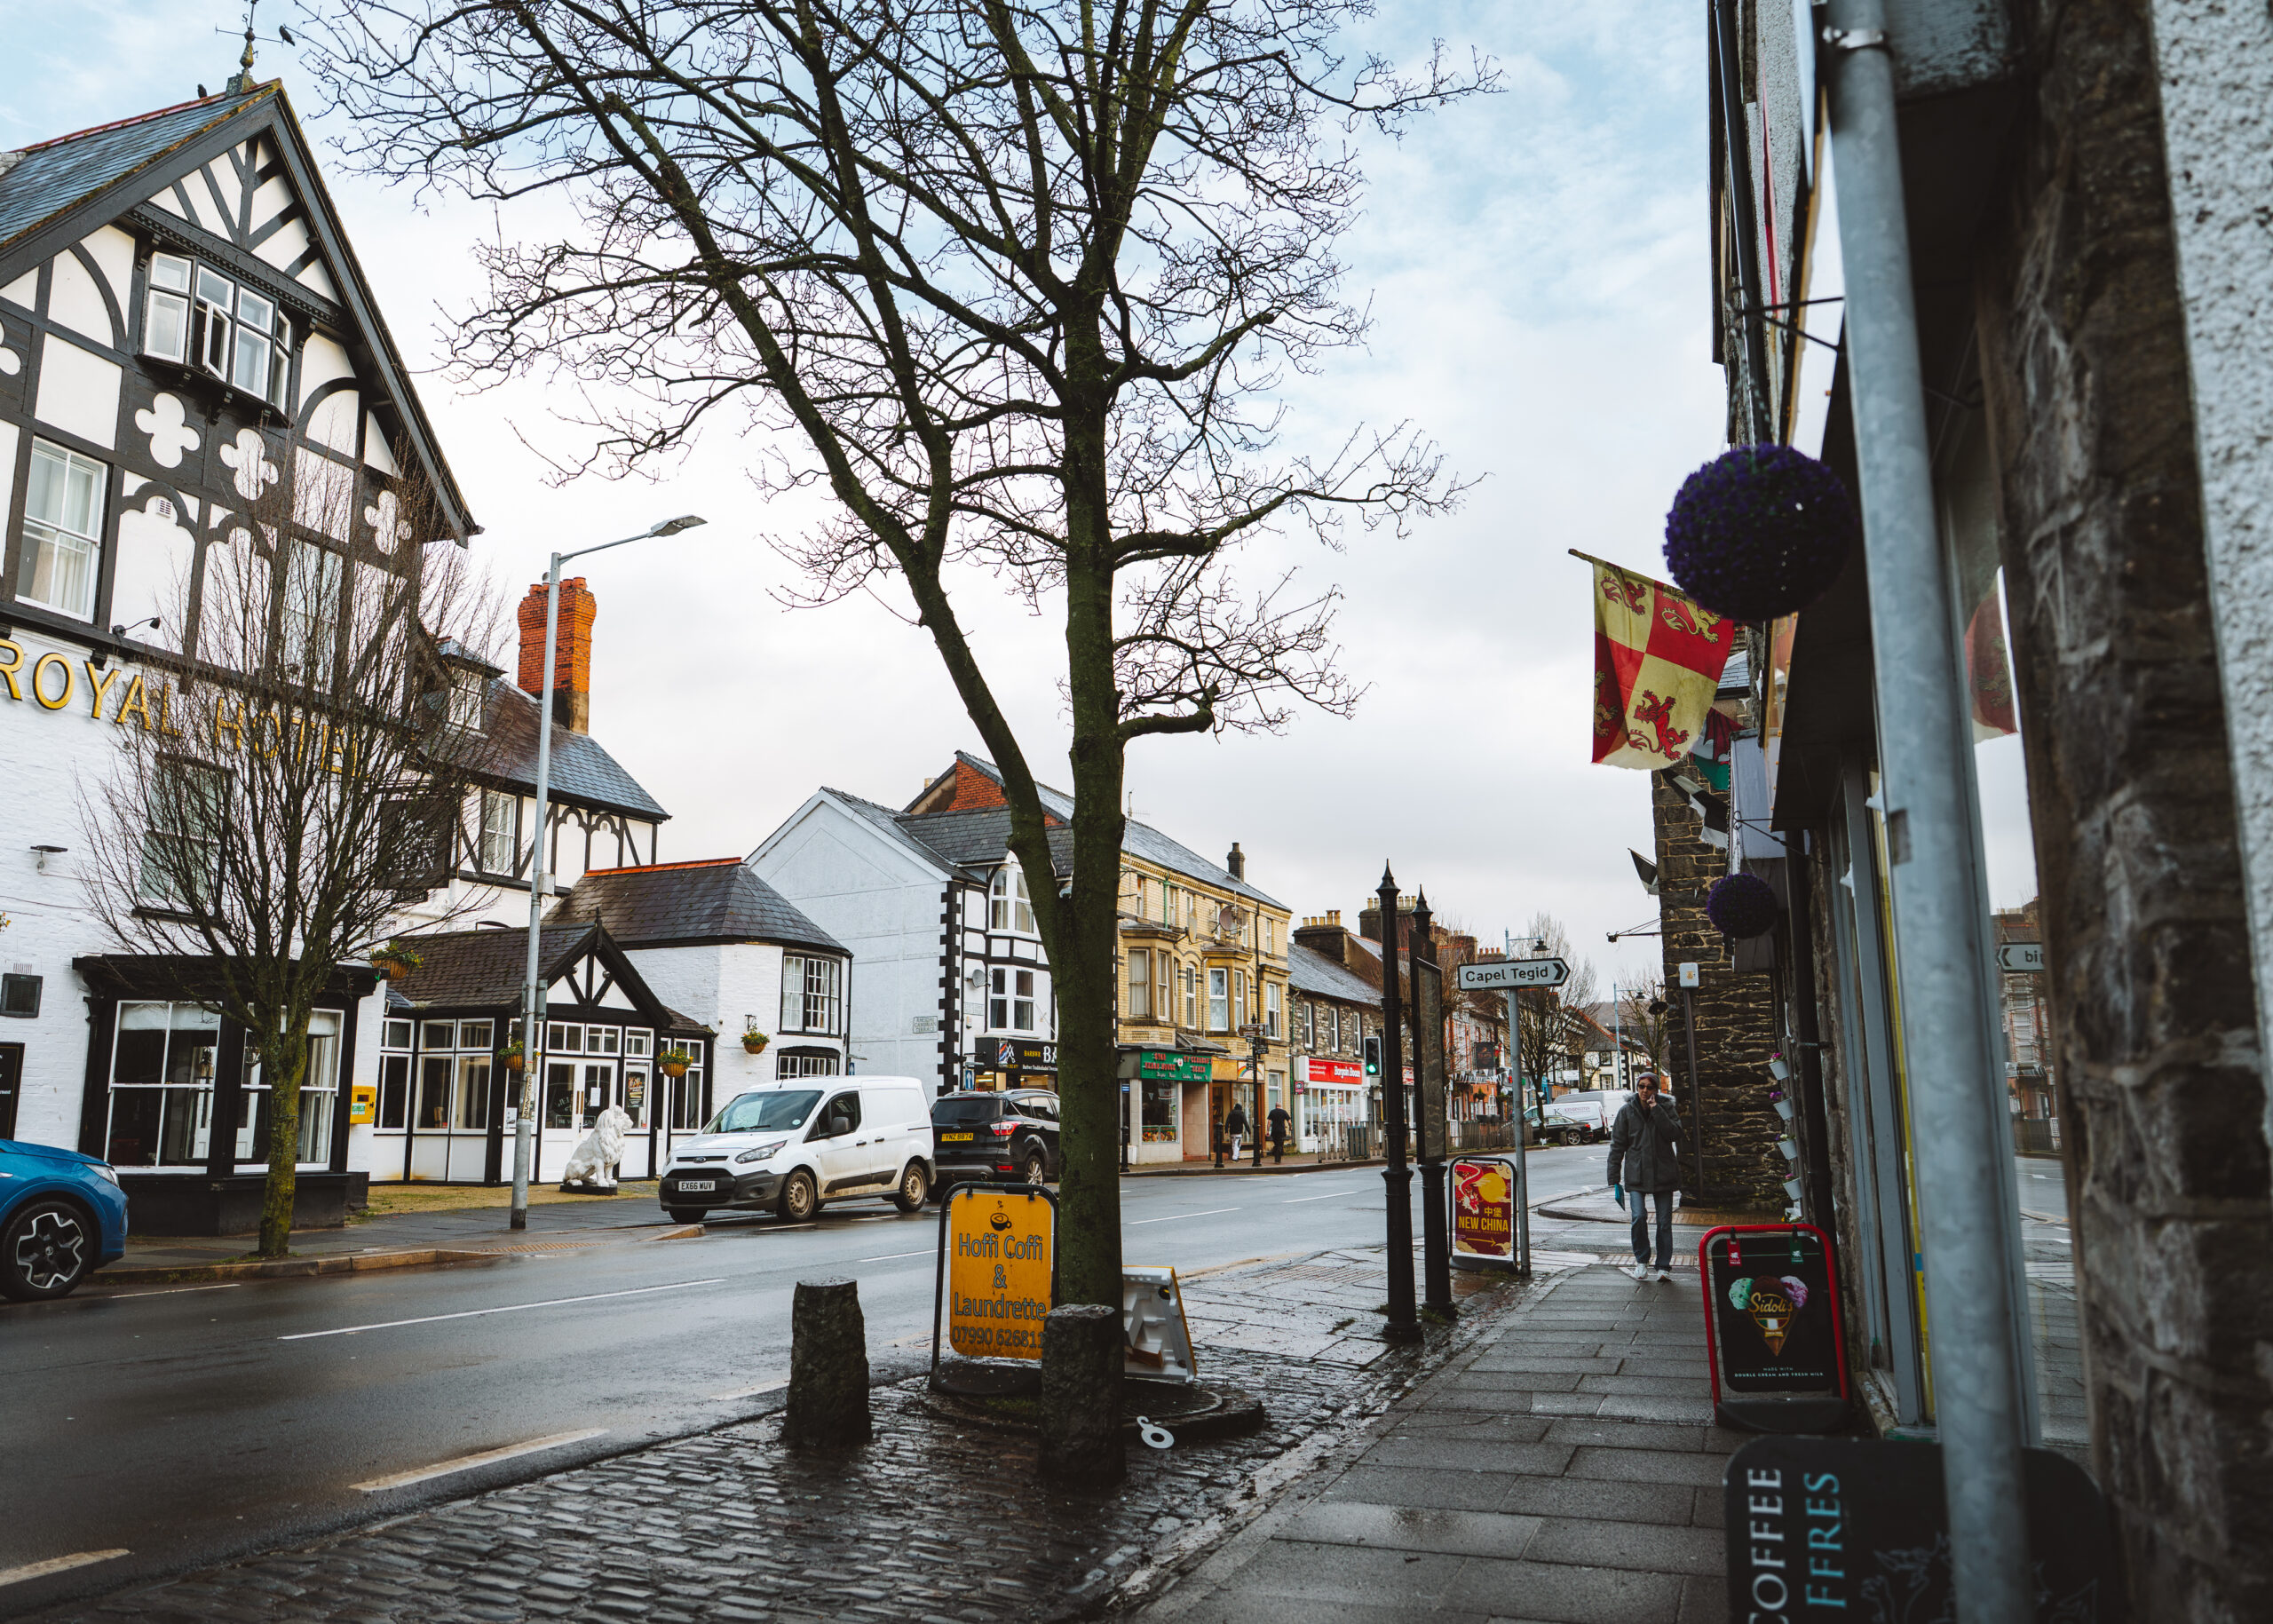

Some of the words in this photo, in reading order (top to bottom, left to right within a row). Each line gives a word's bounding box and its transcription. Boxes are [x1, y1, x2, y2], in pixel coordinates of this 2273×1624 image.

[0, 638, 181, 738] ROYAL
[1465, 969, 1506, 984] Capel
[1510, 966, 1548, 981] Tegid
[1334, 1066, 1349, 1079] Bargain
[1459, 1216, 1478, 1230] NEW
[1481, 1217, 1509, 1232] CHINA
[958, 1232, 999, 1258] Hoffi
[1003, 1234, 1043, 1260] Coffi
[993, 1264, 1008, 1288] &
[954, 1292, 1046, 1321] Laundrette
[1748, 1292, 1793, 1313] Sidoli's
[952, 1326, 994, 1346] 07990
[1803, 1473, 1847, 1608] FFRES
